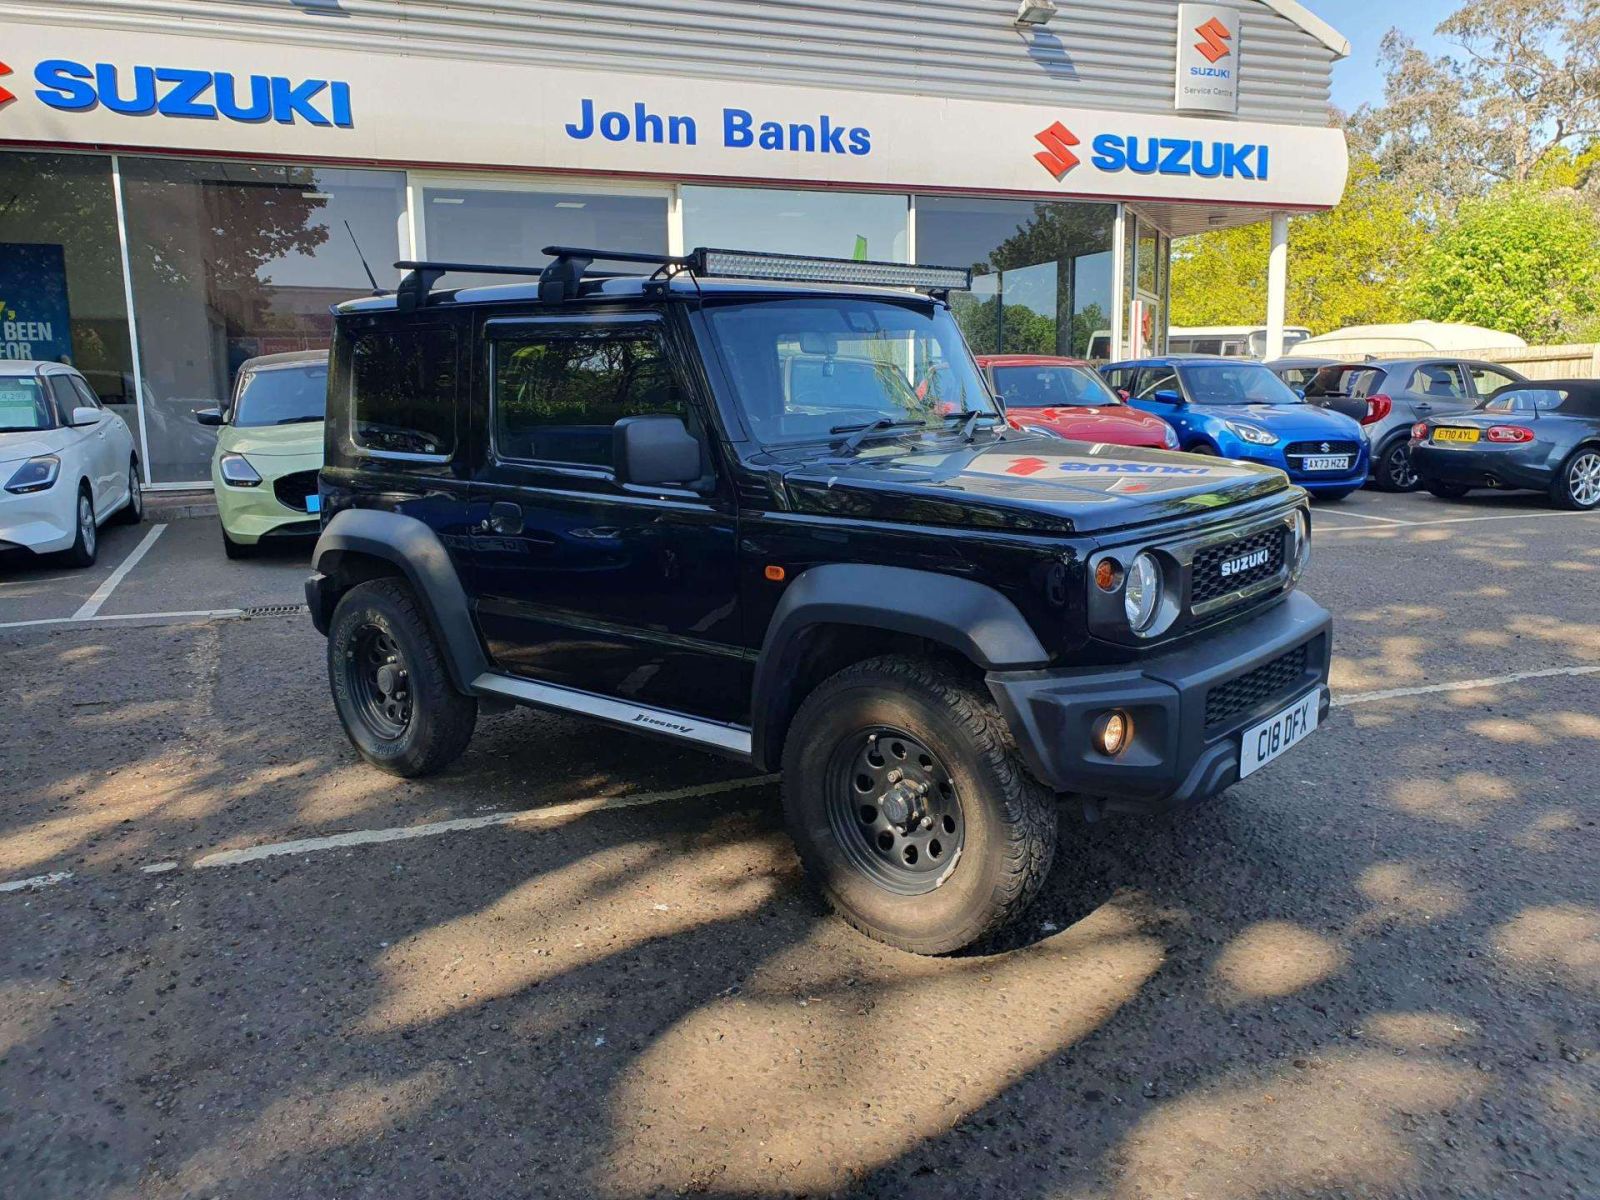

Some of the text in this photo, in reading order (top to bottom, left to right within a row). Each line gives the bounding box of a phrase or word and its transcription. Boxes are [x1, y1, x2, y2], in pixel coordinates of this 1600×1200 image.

[1190, 66, 1231, 79] SUZUKI
[34, 59, 353, 128] SUZUKI
[1184, 87, 1211, 95] Service
[565, 98, 871, 156] John Banks
[1091, 133, 1269, 181] SUZUKI
[3, 320, 53, 341] BEEN
[1457, 430, 1473, 440] AYL
[1308, 459, 1329, 469] AX73
[1331, 458, 1347, 468] HZZ
[1221, 549, 1269, 577] SUZUKI
[1257, 702, 1309, 762] C18 DFX
